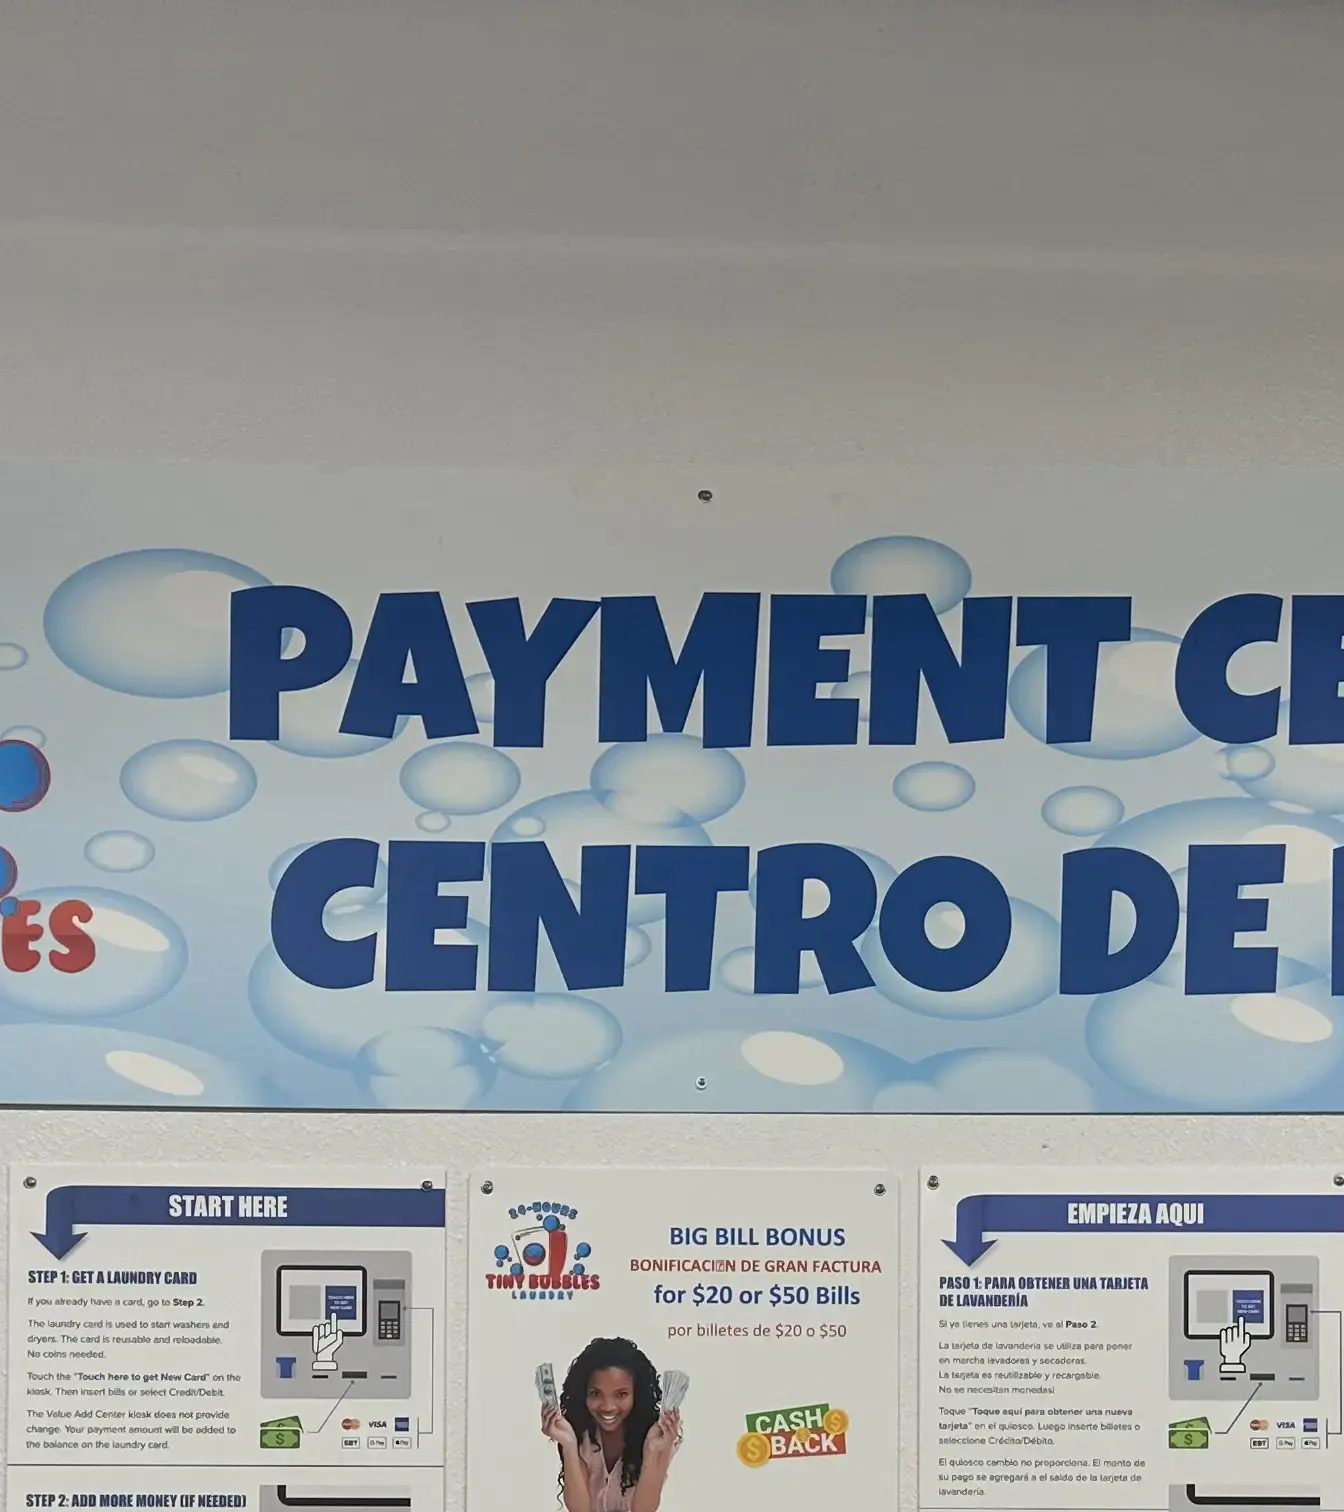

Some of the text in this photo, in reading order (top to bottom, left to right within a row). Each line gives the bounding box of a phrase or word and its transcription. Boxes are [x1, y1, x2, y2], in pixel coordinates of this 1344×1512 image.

[229, 584, 1131, 750] PAYMENT
[268, 837, 1013, 998] CENTRO
[1058, 843, 1288, 998] DE
[167, 1194, 287, 1217] START HERE
[1067, 1202, 1204, 1226] EMPIEZA AQUI
[670, 1227, 845, 1246] BIG BILL BONUS
[740, 1259, 882, 1273] DE GRAN FACTURA
[28, 1270, 57, 1283] STEP
[72, 1270, 94, 1284] GET
[96, 1270, 104, 1283] A
[106, 1270, 161, 1284] LAUNDRY
[164, 1271, 197, 1284] CARD
[485, 1274, 600, 1291] TINY BUBBLES
[939, 1276, 970, 1289] PASO
[984, 1276, 1016, 1290] PARA
[1018, 1276, 1070, 1289] OBTENER
[1072, 1276, 1097, 1290] UNA
[1099, 1276, 1148, 1290] TARJETA
[35, 1298, 52, 1307] you
[54, 1297, 88, 1307] already
[90, 1297, 112, 1306] have
[146, 1299, 159, 1308] go
[161, 1298, 170, 1306] to
[172, 1297, 194, 1308] Step
[512, 1291, 574, 1300] LAUNDRY
[653, 1282, 860, 1307] for $20 or $50 Bills
[939, 1291, 1028, 1307] DE LAVANDERÍA
[667, 1322, 846, 1339] por billetes de $20 o $50
[755, 1410, 838, 1457] CASH BACK
[25, 1493, 55, 1507] STEP
[71, 1494, 96, 1507] ADD
[99, 1494, 133, 1507] MORE
[135, 1494, 177, 1507] MONEY
[180, 1494, 195, 1507] (IF
[197, 1494, 246, 1507] NEEDED)
